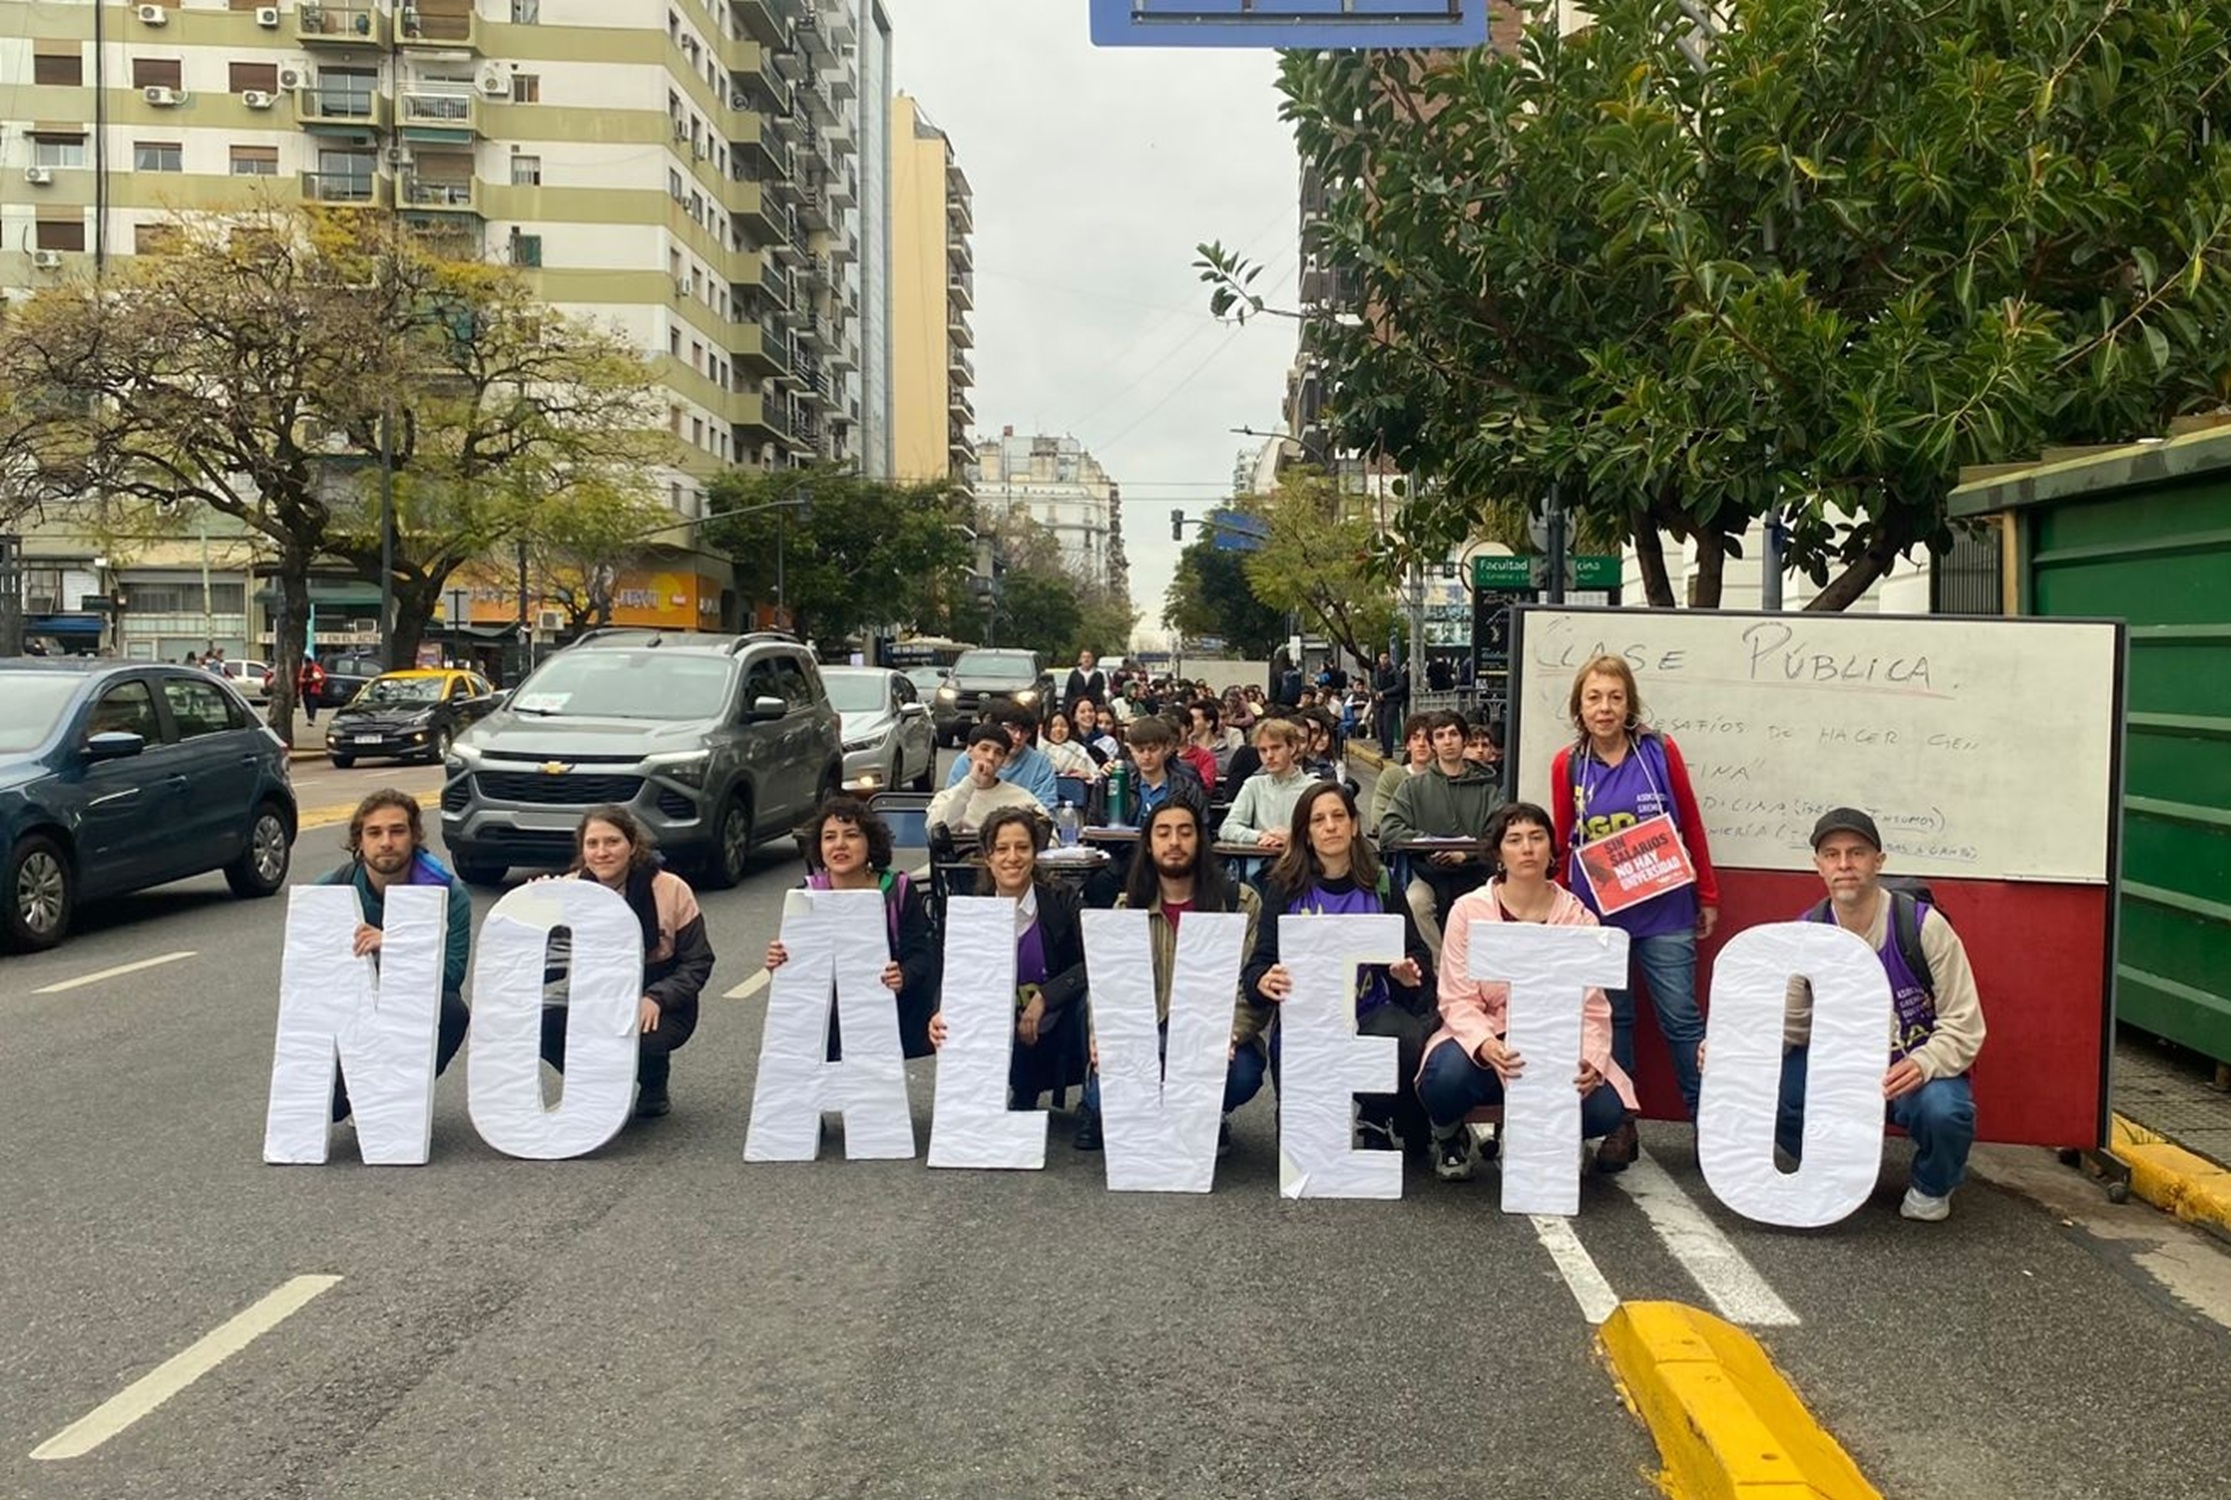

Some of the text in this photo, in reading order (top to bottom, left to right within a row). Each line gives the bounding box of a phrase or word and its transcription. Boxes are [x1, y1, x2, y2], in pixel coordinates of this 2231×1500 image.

[1480, 559, 1529, 572] Facultad
[1604, 835, 1627, 855] SIN
[1609, 832, 1669, 868] SALARIOS
[1614, 862, 1635, 878] NO
[1634, 850, 1659, 871] HAY
[1619, 855, 1682, 891] UNIVERSIDAD
[263, 879, 1892, 1228] NO AL VETO
